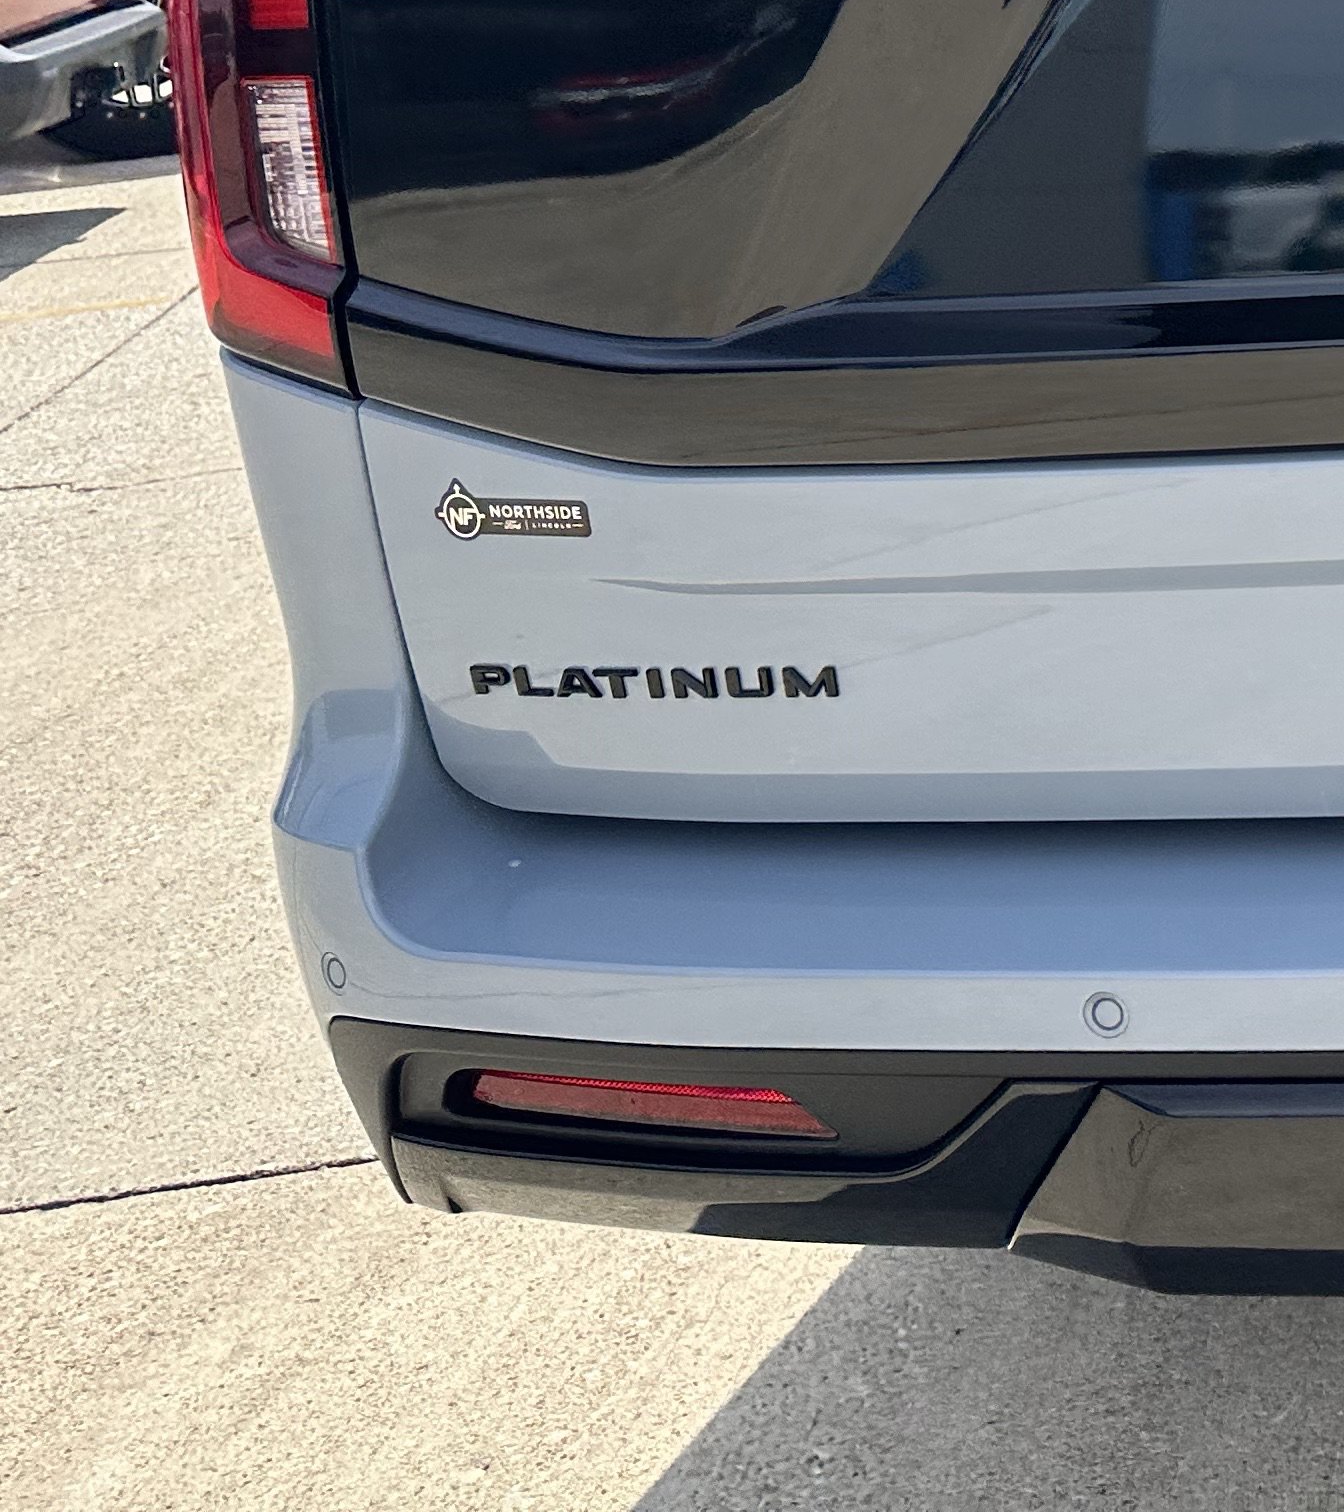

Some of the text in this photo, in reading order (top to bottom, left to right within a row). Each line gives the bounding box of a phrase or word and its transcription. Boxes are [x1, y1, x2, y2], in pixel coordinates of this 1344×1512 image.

[449, 506, 476, 529] NF
[488, 504, 583, 520] NORTHSIDE
[532, 522, 572, 530] LINCOLN
[469, 664, 840, 699] PLATINUM
